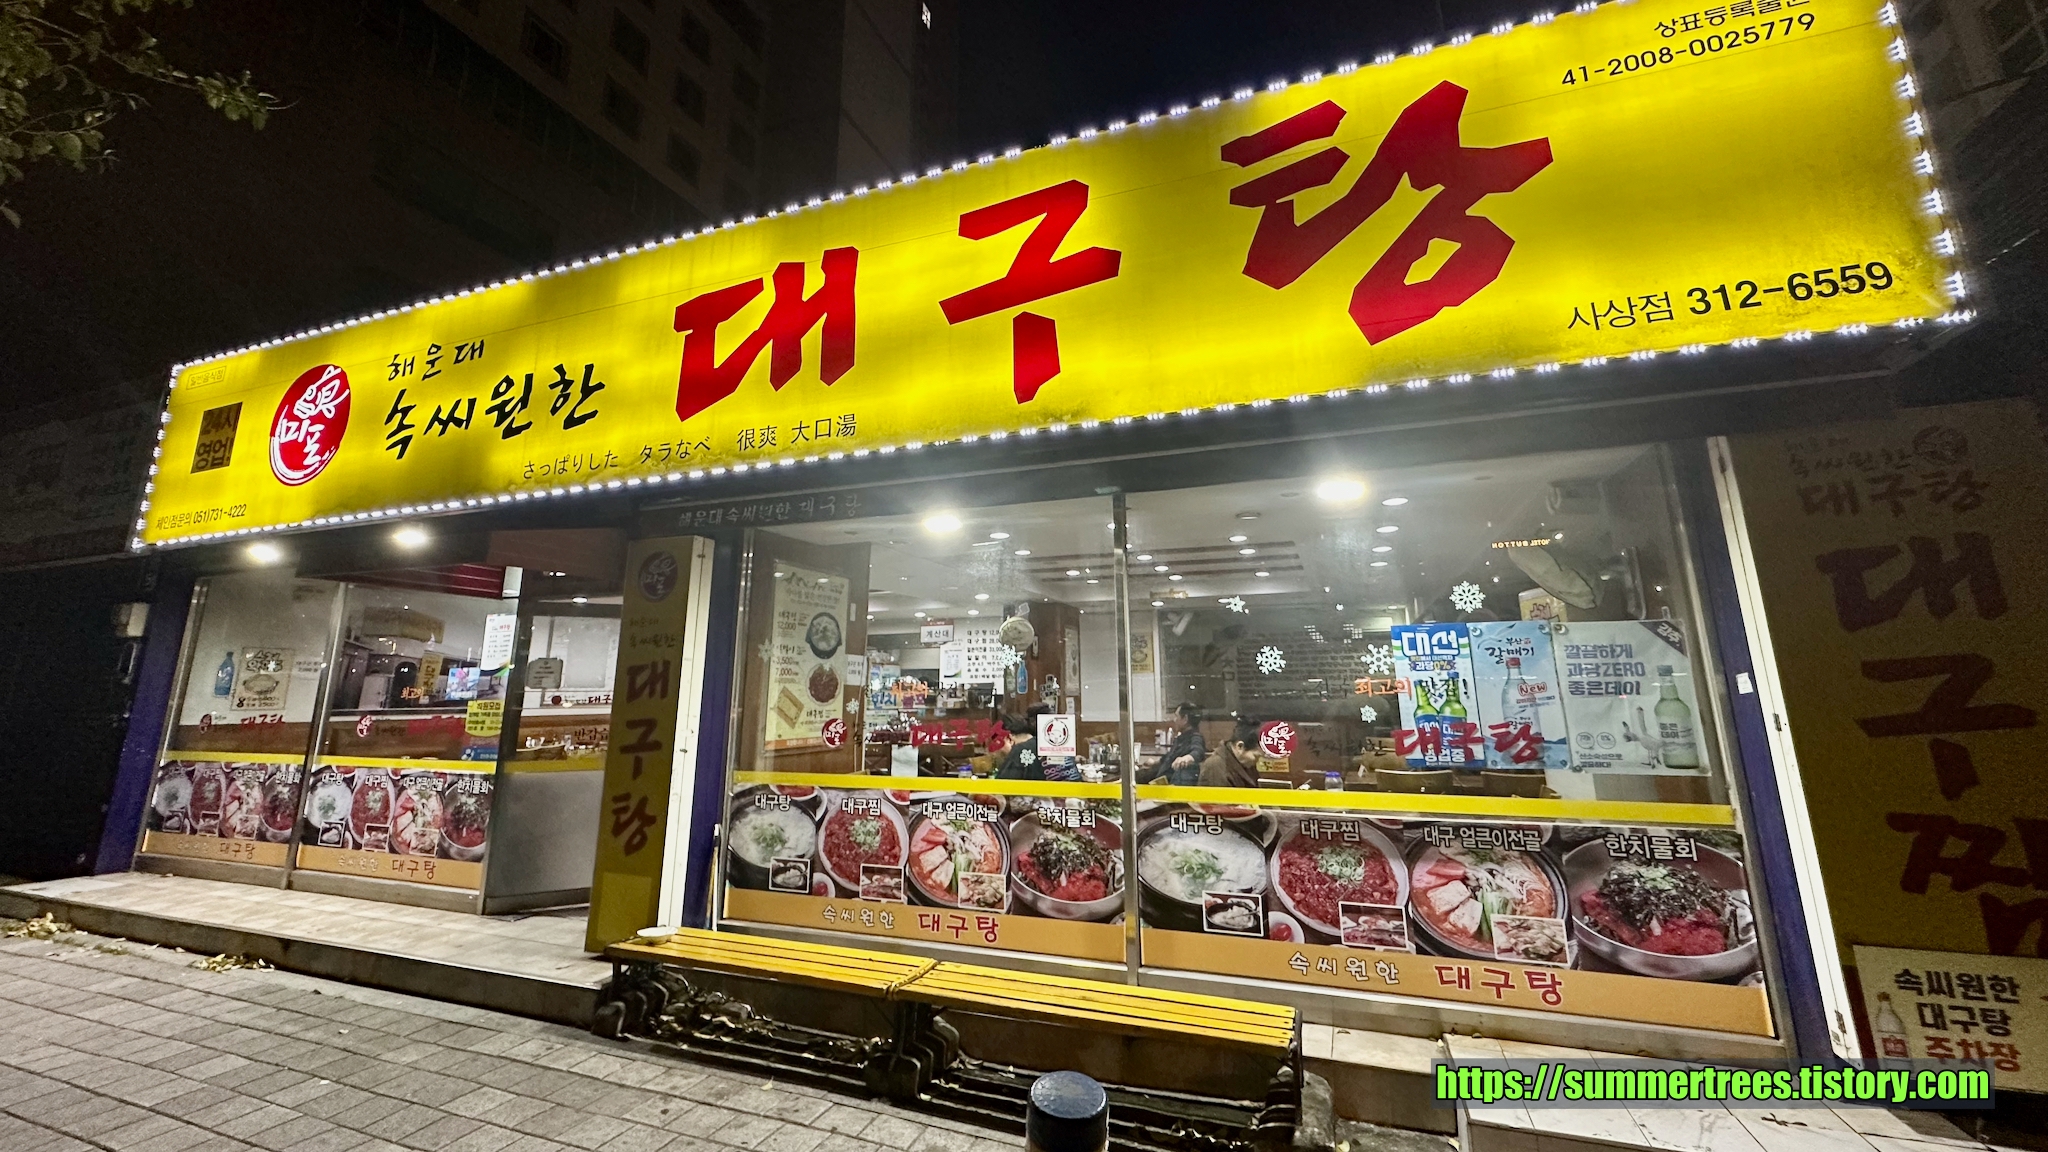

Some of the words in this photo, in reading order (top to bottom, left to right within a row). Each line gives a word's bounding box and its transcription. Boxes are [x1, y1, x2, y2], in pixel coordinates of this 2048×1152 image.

[1654, 0, 1810, 38] 상표등록출
[1562, 13, 1815, 85] 41-2008-0025779
[674, 80, 1553, 421] 대구탕
[1567, 291, 1674, 331] 사상점
[1686, 261, 1893, 315] 312-6559
[387, 339, 485, 381] 해운대
[384, 363, 606, 460] 속씨원한
[736, 424, 779, 452] 很爽
[790, 413, 857, 445] 大口湯
[523, 450, 619, 480] さっぱりした
[639, 435, 712, 465] タラなべ
[1798, 470, 1991, 518] 대구탕
[155, 511, 193, 531] 체인점문의
[193, 503, 247, 525] 051)731-4222
[926, 629, 950, 639] 계산대
[1401, 630, 1459, 656] 대선
[1484, 646, 1535, 664] 갈매기
[1564, 643, 1634, 660] 깔끔하게
[1566, 661, 1646, 678] 과당ZERO
[1519, 683, 1546, 695] New
[1568, 680, 1641, 696] 좋은데이
[911, 718, 1012, 752] 대구탕
[1390, 721, 1545, 765] 대구탕
[612, 659, 671, 857] 대구탕
[322, 772, 345, 786] 대구탕
[366, 774, 389, 789] 대구찜
[457, 779, 491, 795] 한치물회
[755, 793, 792, 812] 대구탕
[842, 797, 882, 817] 대구찜
[922, 801, 944, 819] 대구
[945, 801, 999, 823] 얼큰이전골
[1037, 806, 1097, 829] 한치물회
[1170, 812, 1224, 835] 대구탕
[1300, 819, 1360, 842] 대구찜
[1424, 825, 1456, 848] 대구
[1459, 827, 1543, 853] 얼큰이전골
[1604, 832, 1699, 862] 한치물회
[392, 858, 437, 880] 대구탕
[822, 904, 895, 930] 속씨원한
[917, 913, 999, 944] 대구탕
[1288, 950, 1401, 985] 속씨원한
[1433, 964, 1564, 1007] 대구탕
[1894, 968, 2021, 1005] 속씨원한
[1916, 1001, 2013, 1038] 대구탕
[1923, 1035, 2021, 1073] 주차장
